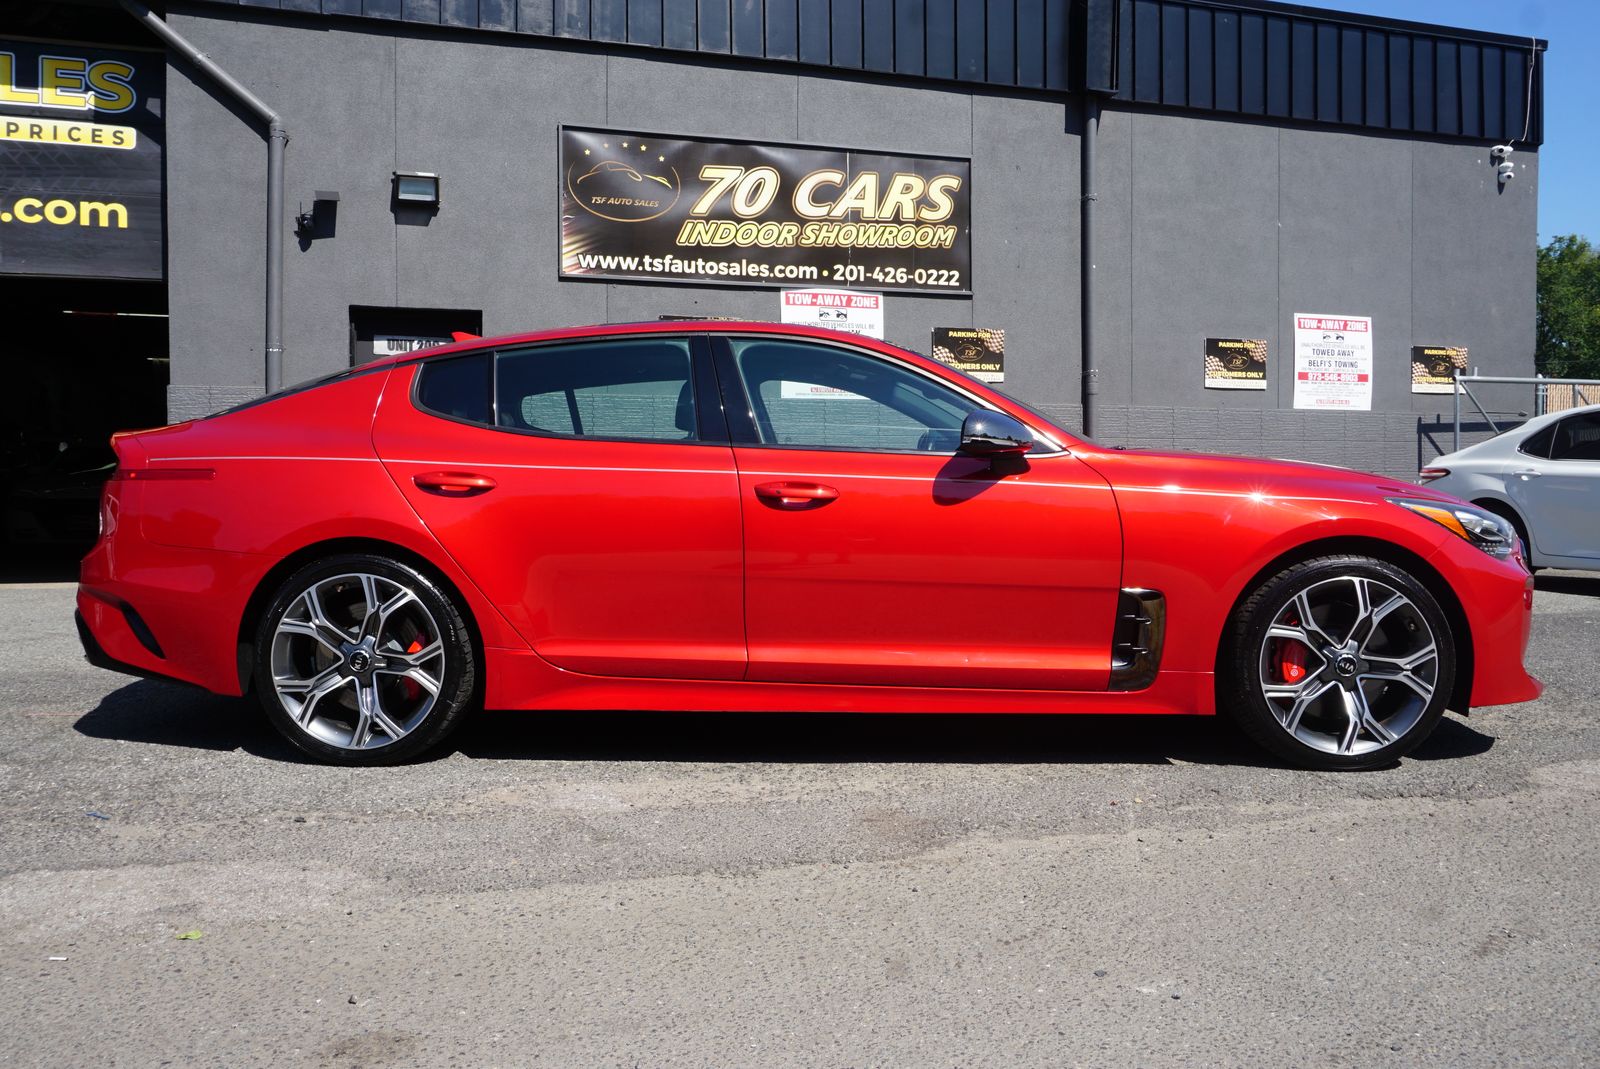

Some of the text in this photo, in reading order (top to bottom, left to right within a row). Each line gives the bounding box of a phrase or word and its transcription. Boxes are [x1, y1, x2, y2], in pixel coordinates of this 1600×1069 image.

[6, 122, 124, 145] PRICES
[689, 165, 962, 222] 70 CARS
[591, 196, 660, 208] TSF AUTO SALES
[676, 220, 957, 249] INDOOR SHOWROOM
[578, 253, 960, 287] www.tsfautosales.com 201-426-0222
[787, 293, 877, 308] TOW-AWAY ZONE
[1300, 319, 1367, 331] TOW-AWAY ZONE
[948, 330, 977, 338] PARKING
[386, 339, 414, 352] UNIT
[1312, 348, 1355, 357] TOWED AWAY
[981, 363, 1001, 371] ONLY
[1334, 361, 1359, 369] TOWING
[1340, 661, 1354, 672] KIA
